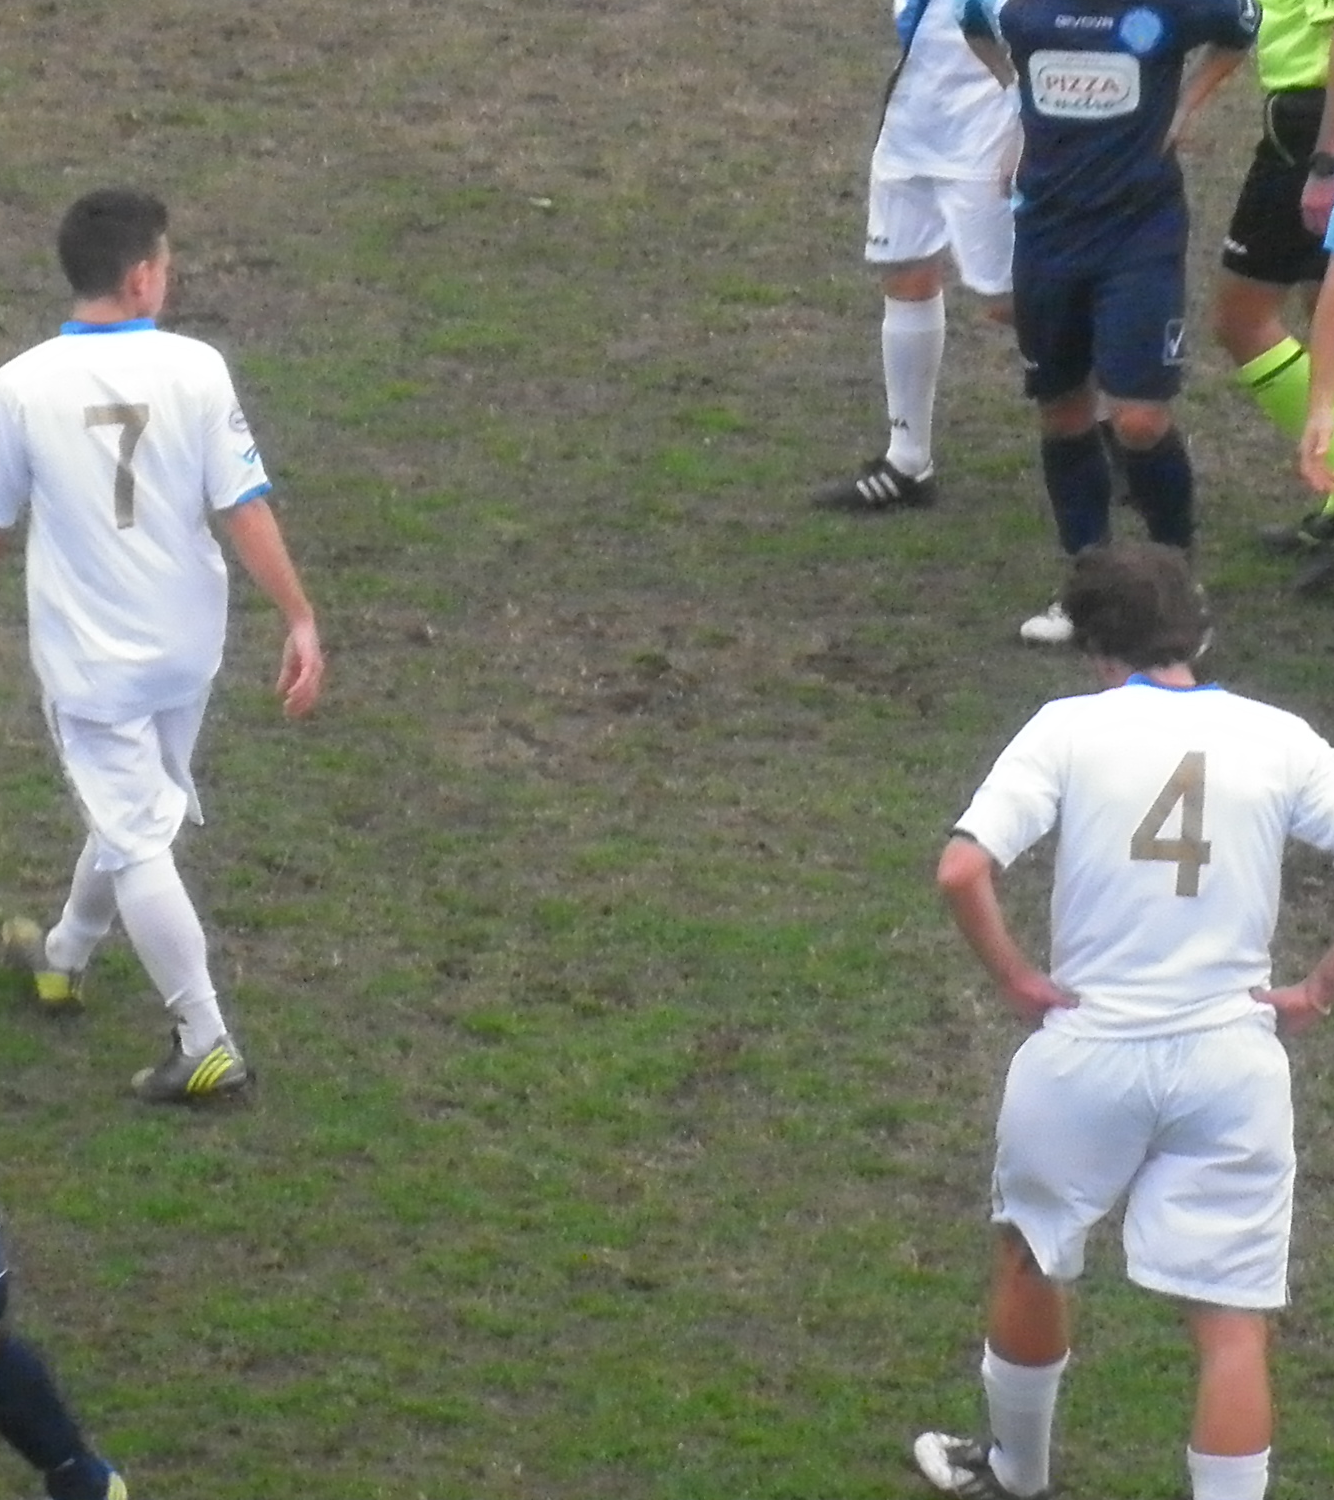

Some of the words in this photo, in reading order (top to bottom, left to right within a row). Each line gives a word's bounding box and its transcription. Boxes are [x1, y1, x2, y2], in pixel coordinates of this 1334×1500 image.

[1046, 75, 1119, 92] PIZZA
[84, 404, 150, 529] 7
[1130, 751, 1211, 897] 4
